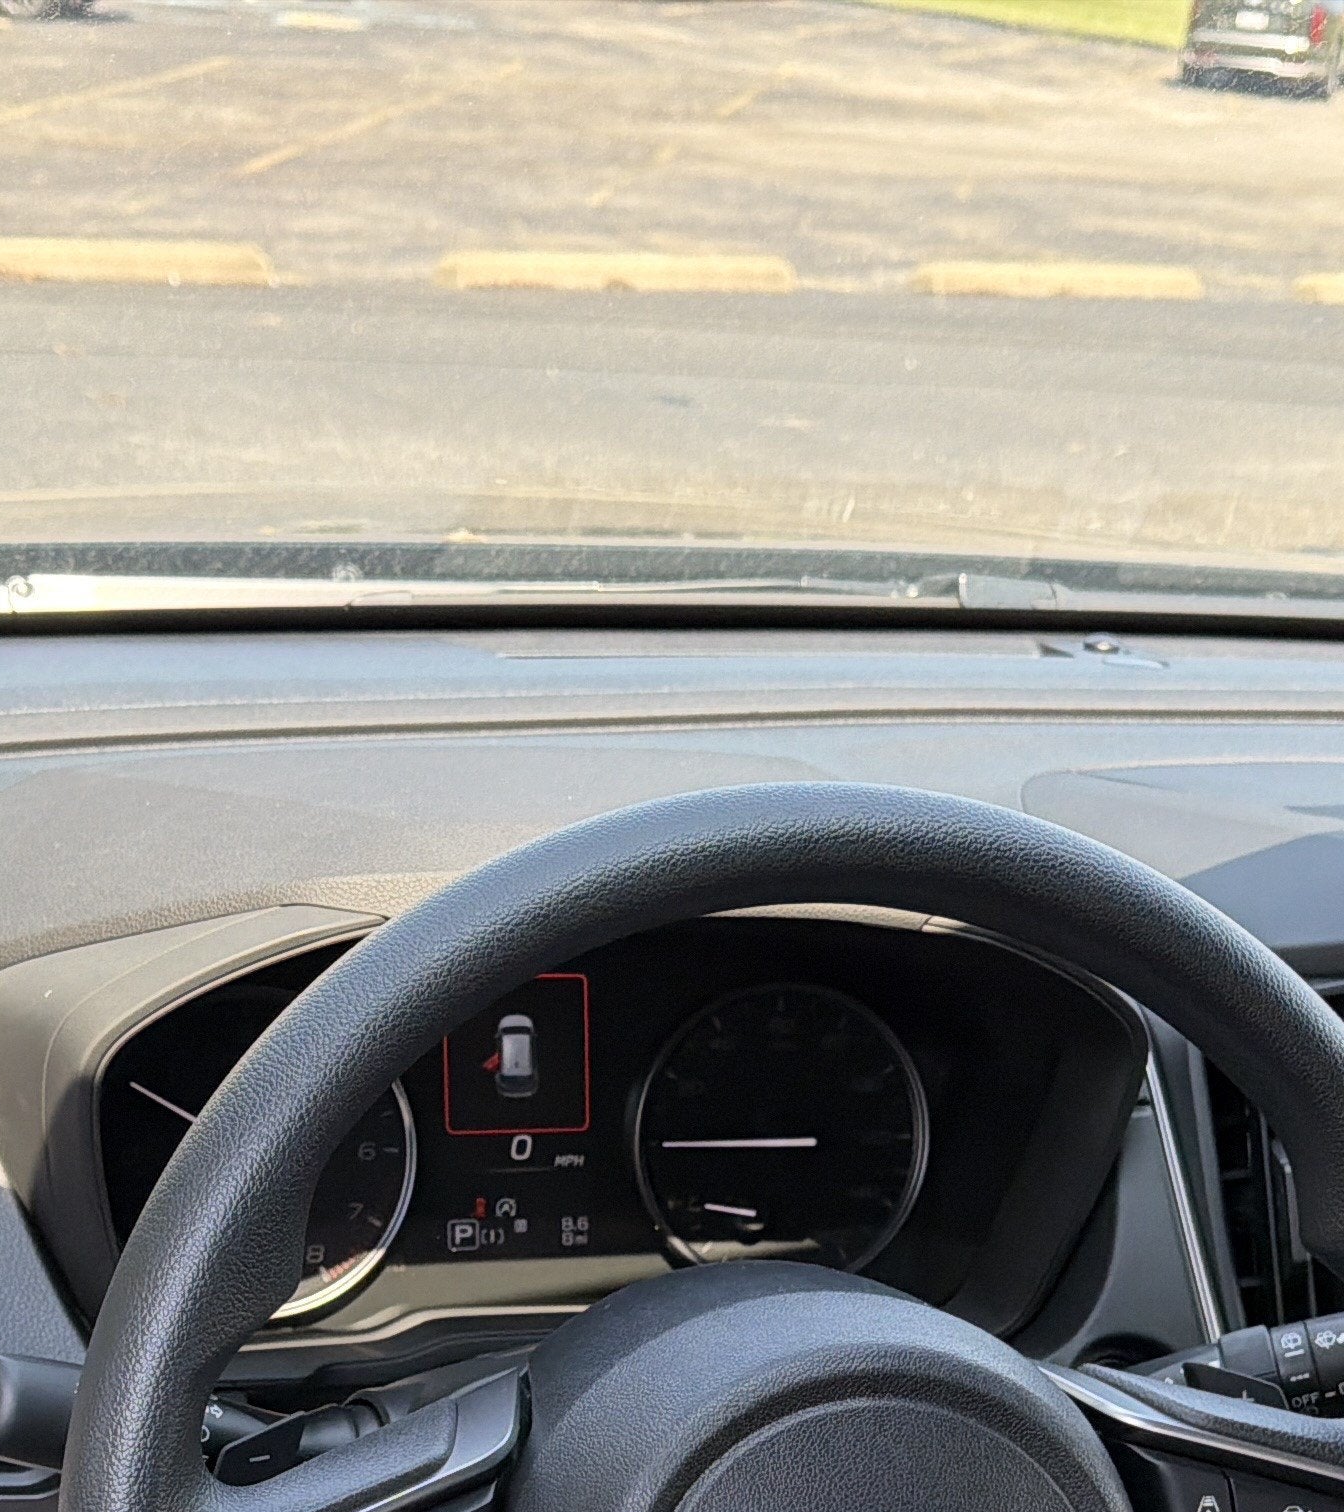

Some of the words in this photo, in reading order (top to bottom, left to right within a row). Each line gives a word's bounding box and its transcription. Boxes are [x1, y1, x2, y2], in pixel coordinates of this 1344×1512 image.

[358, 1141, 376, 1161] 6
[510, 1134, 533, 1161] 0
[553, 1154, 584, 1168] MPH
[349, 1202, 364, 1220] 7
[454, 1224, 474, 1245] P
[307, 1244, 325, 1264] 8
[1291, 1391, 1321, 1408] OFF
